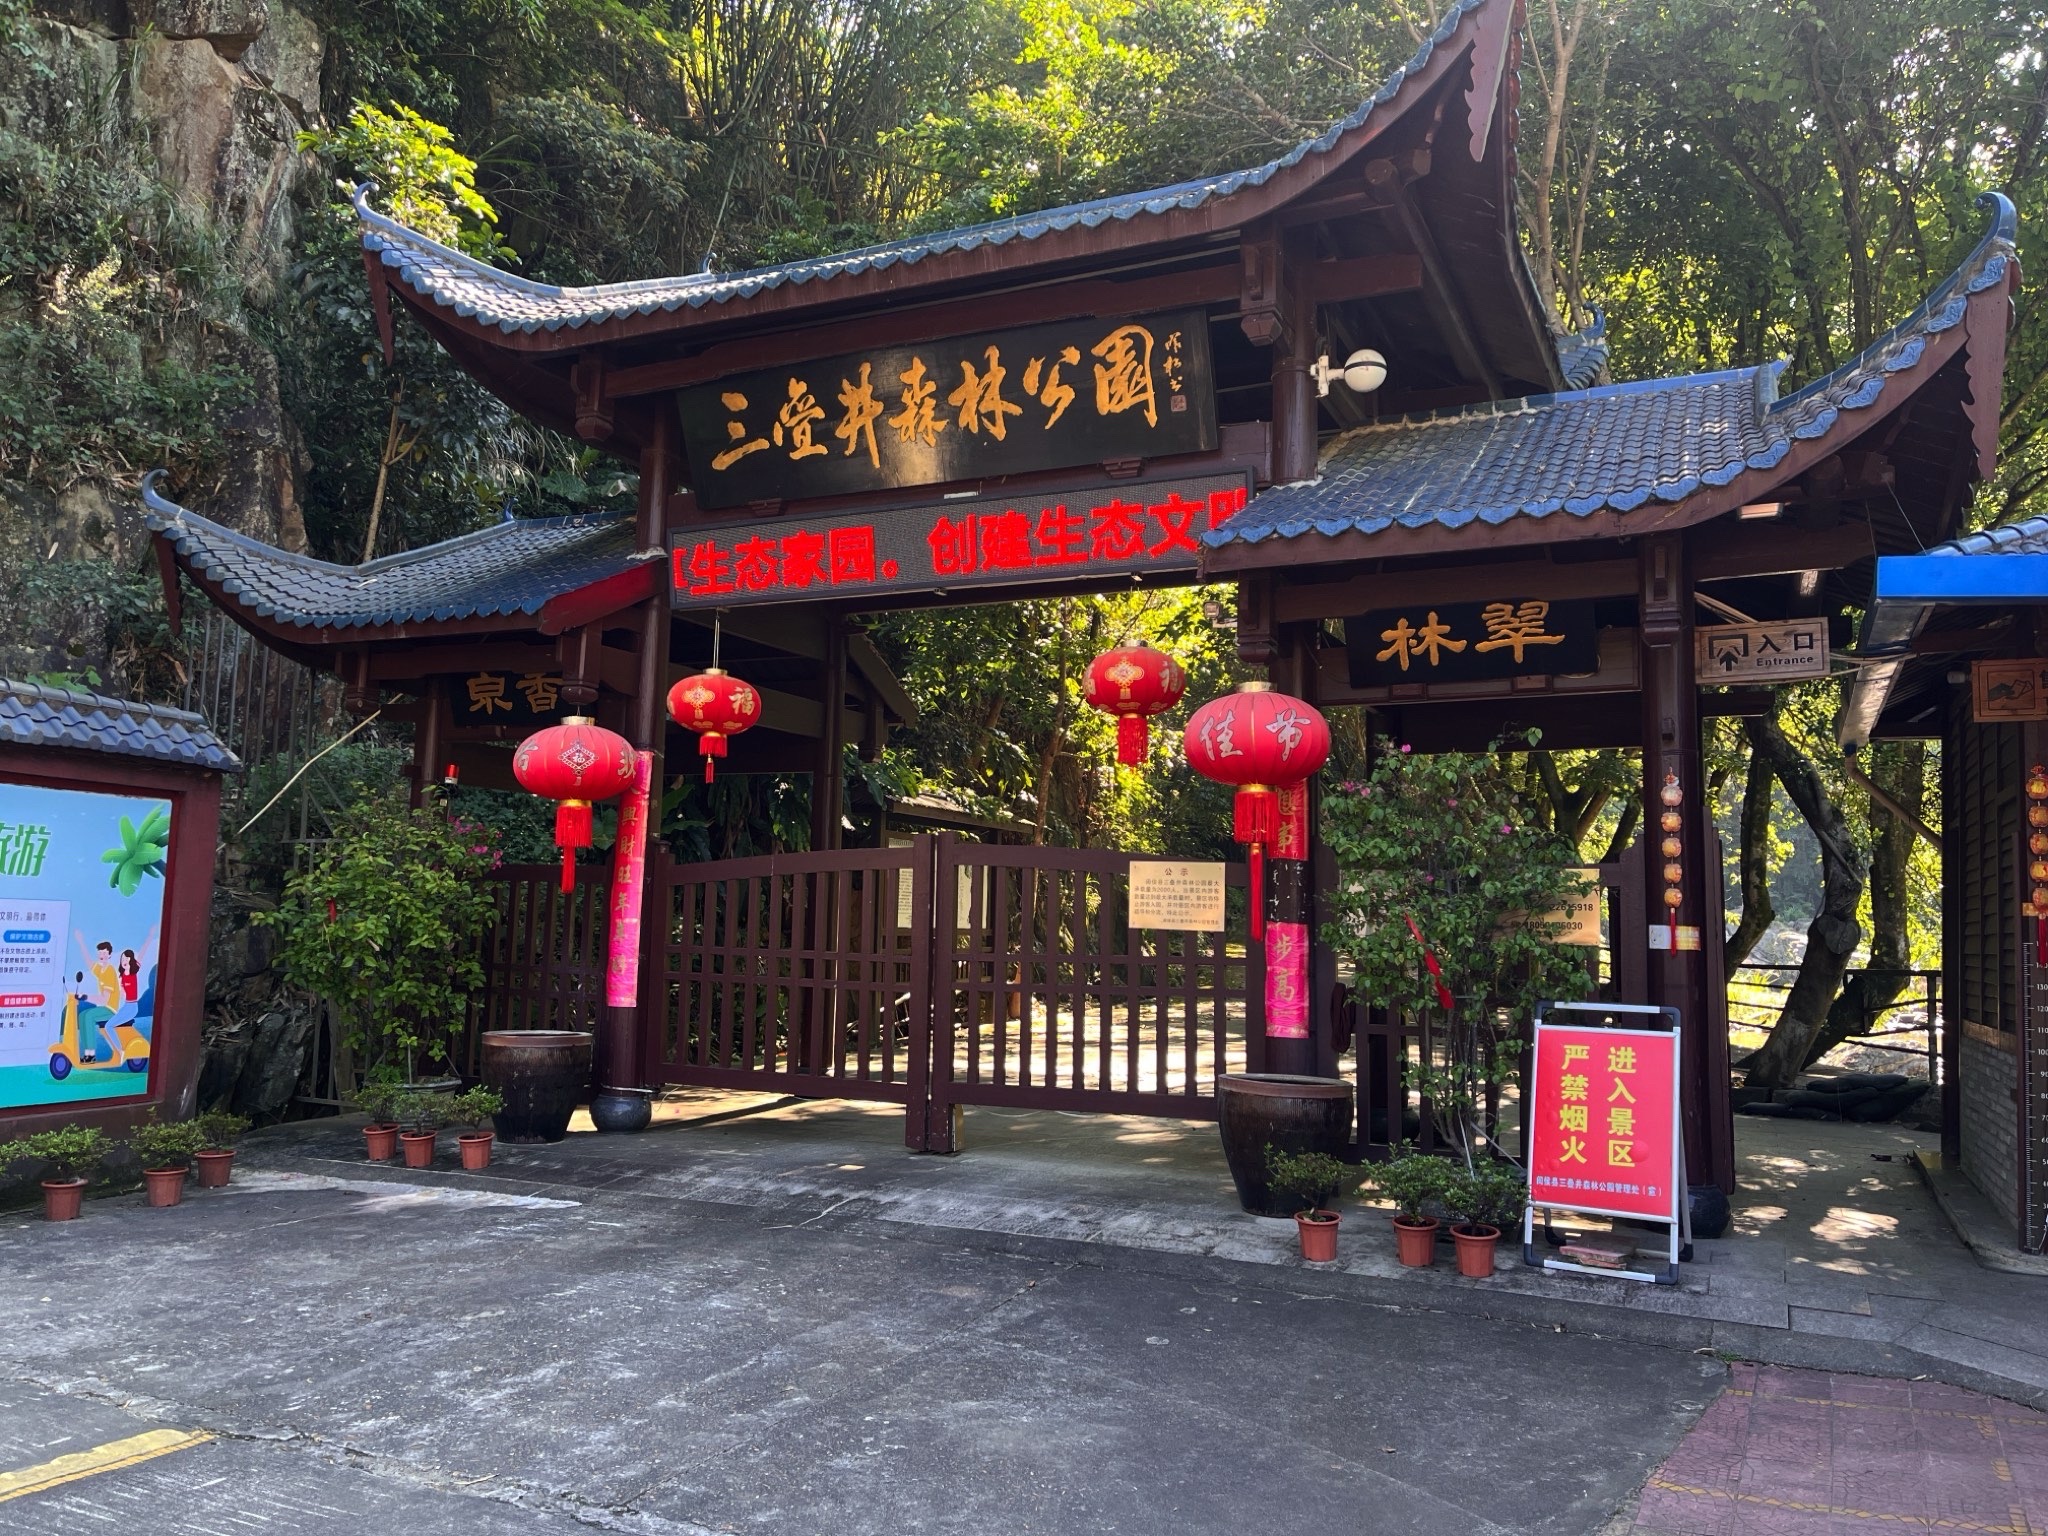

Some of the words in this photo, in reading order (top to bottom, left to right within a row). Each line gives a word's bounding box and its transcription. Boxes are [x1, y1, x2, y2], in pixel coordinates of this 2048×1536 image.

[1757, 633, 1813, 654] 入口
[1756, 655, 1814, 667] Entrance
[1164, 867, 1189, 877] 公示
[1559, 1044, 1591, 1165] 严禁烟火
[1606, 1046, 1637, 1168] 进入景区
